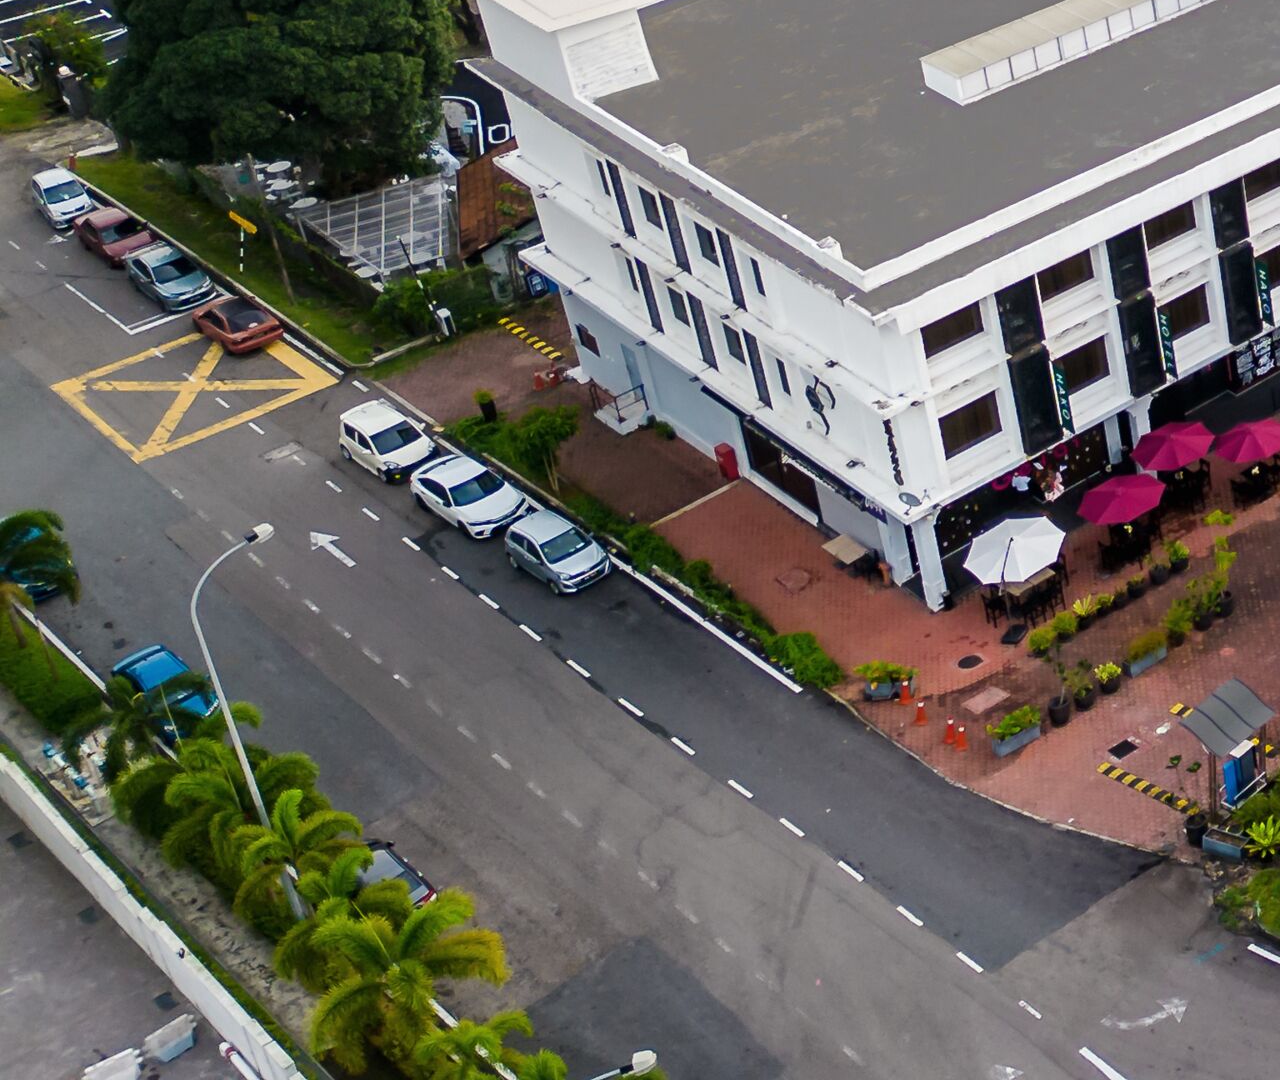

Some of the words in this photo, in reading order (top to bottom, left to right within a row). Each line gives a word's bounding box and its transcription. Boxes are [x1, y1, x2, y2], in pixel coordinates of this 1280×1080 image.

[1258, 269, 1271, 314] HAKO
[1159, 314, 1174, 368] HOTEL
[1055, 372, 1071, 420] HAKO
